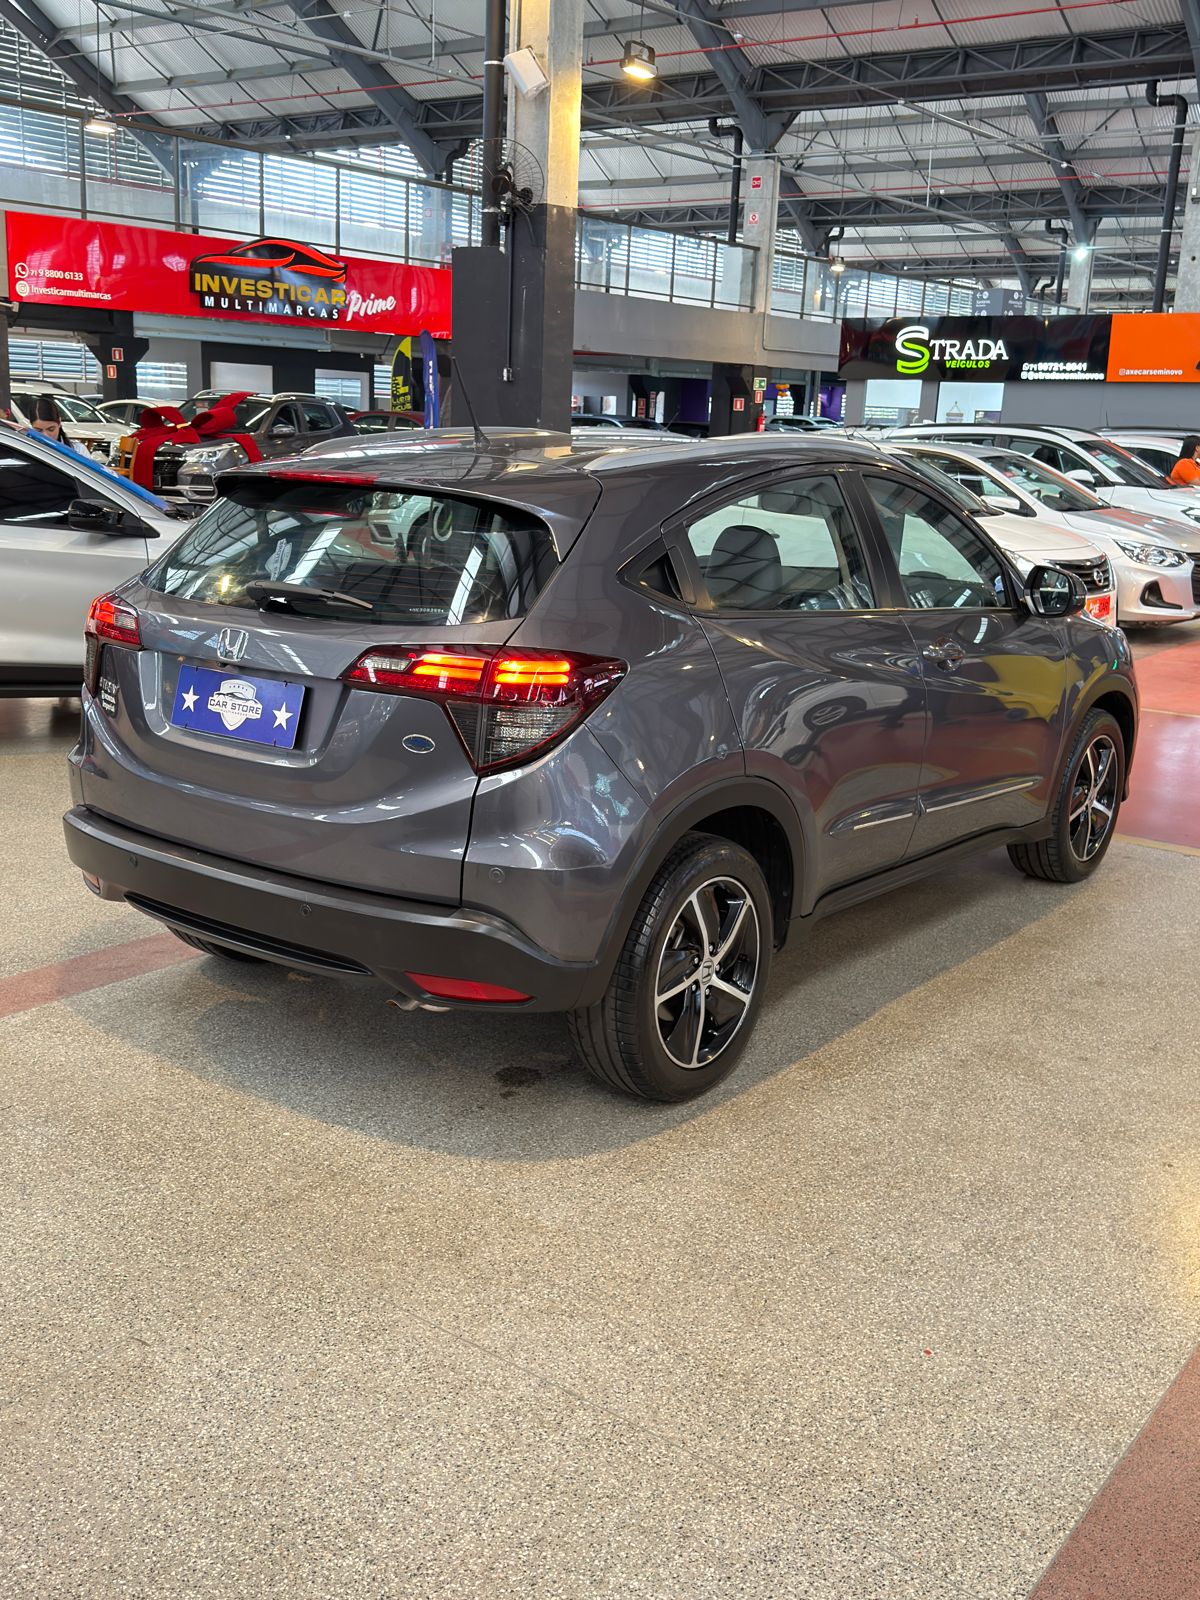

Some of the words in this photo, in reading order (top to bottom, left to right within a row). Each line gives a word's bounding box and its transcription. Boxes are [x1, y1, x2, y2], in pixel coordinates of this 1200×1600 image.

[45, 269, 64, 279] 8800
[64, 271, 84, 281] 6133
[194, 272, 346, 306] INVESTICAR
[204, 296, 339, 320] MULTIMARCAS
[345, 289, 397, 322] Prime
[895, 325, 1009, 374] STRADA
[945, 359, 991, 369] VEÍCULOS
[209, 698, 228, 709] CAR
[230, 702, 262, 715] STORE
